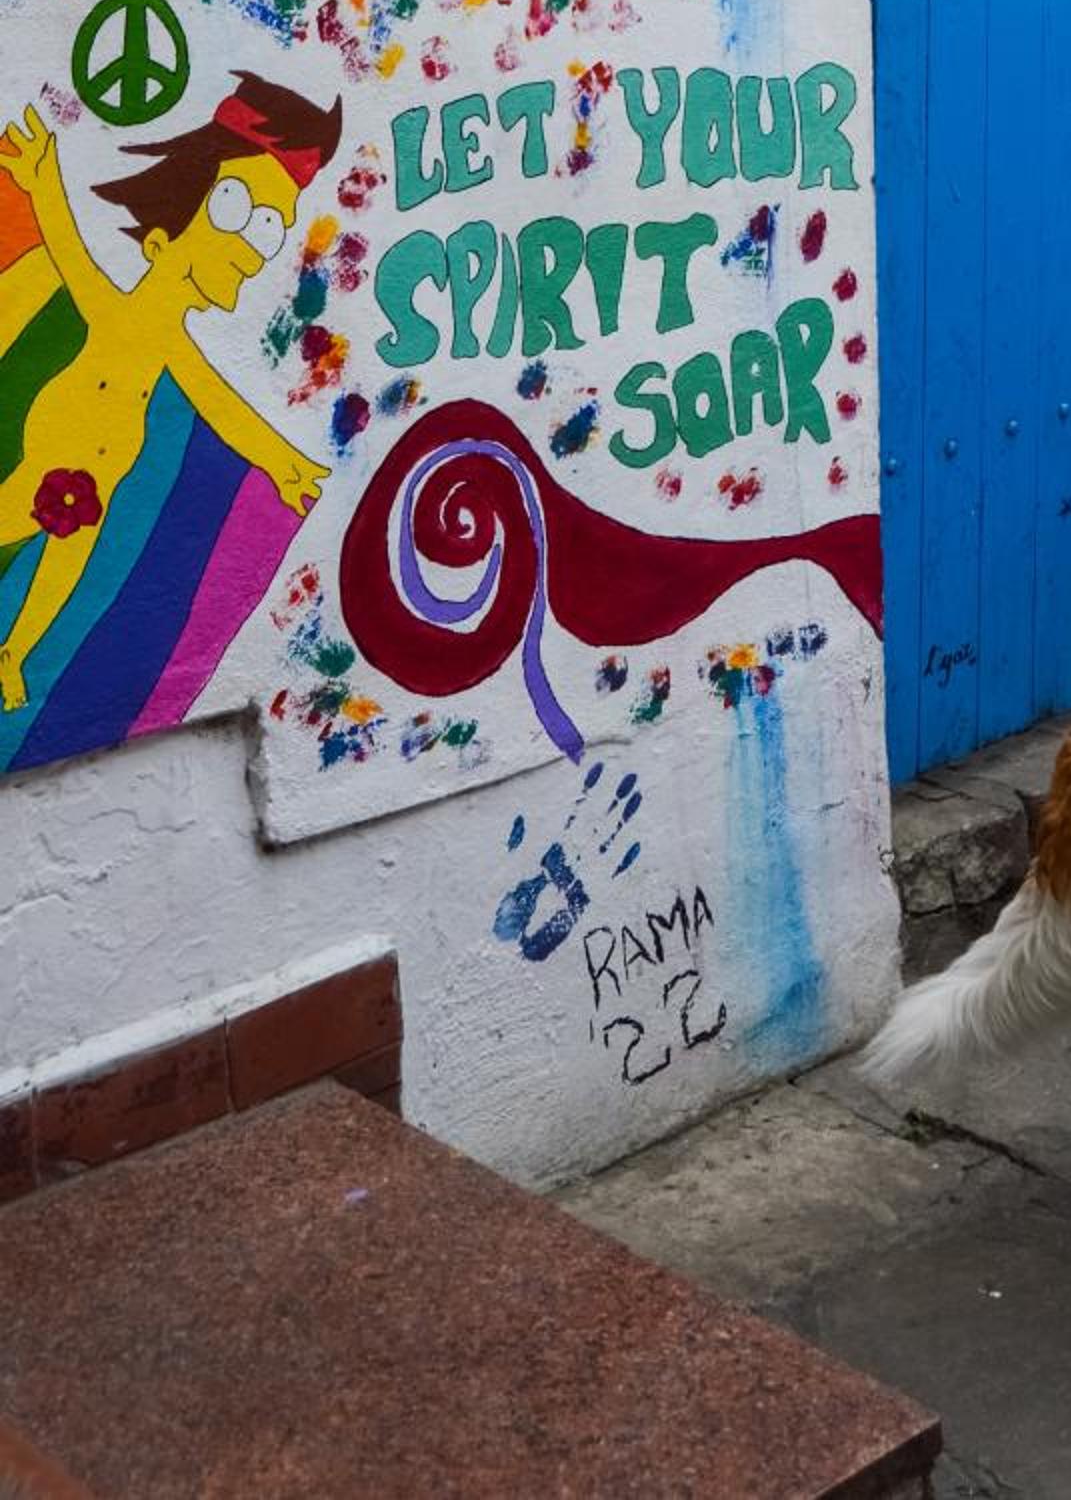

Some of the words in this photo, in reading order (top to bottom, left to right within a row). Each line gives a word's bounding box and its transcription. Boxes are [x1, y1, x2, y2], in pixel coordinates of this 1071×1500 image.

[391, 80, 556, 212] LET
[617, 61, 860, 190] YOUR
[375, 211, 719, 368] SPIRIT
[608, 297, 835, 469] SOAR
[583, 886, 714, 1011] RAMA
